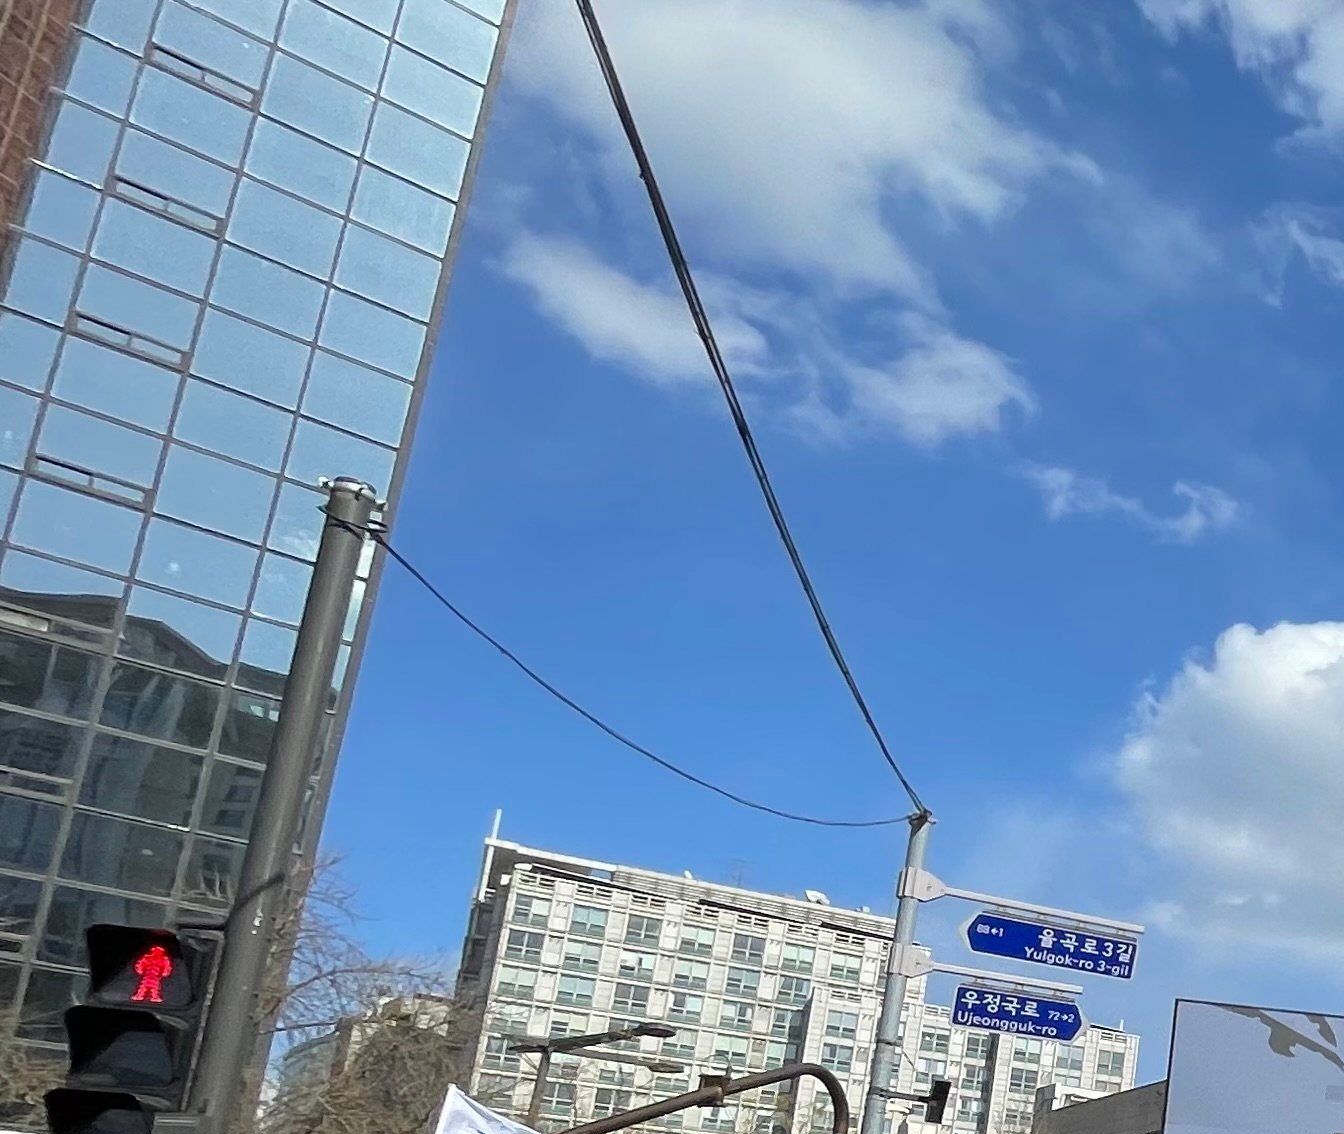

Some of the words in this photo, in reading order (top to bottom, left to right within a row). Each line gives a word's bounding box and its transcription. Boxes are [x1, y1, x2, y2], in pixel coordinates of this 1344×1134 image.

[1038, 928, 1134, 963] 율곡로3길
[1023, 946, 1094, 970] Yulgok-ro
[1096, 960, 1129, 977] 3-gil
[960, 991, 1040, 1018] 우정국로
[956, 1010, 1057, 1036] Ujeongguk-ro
